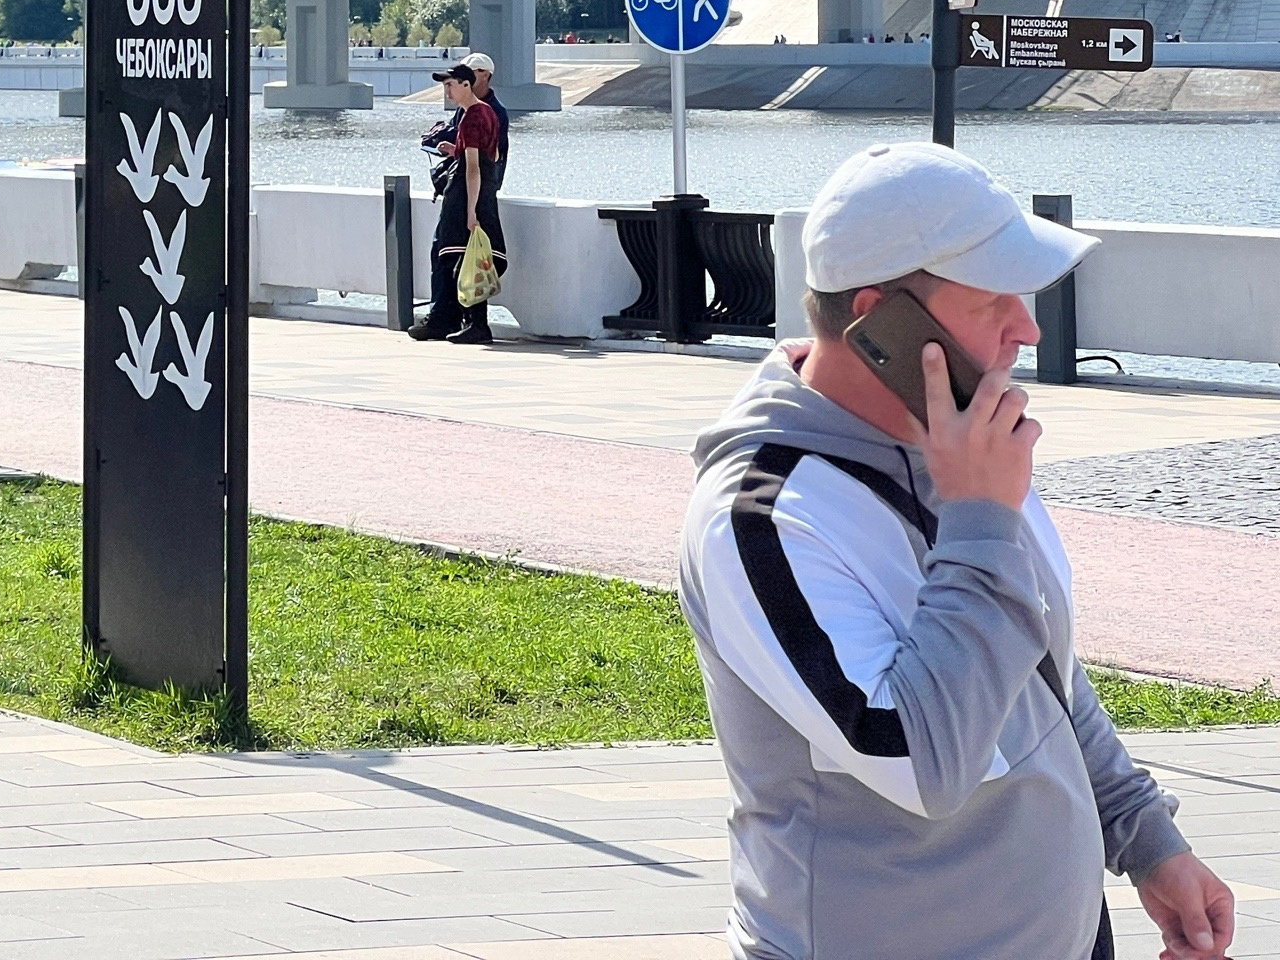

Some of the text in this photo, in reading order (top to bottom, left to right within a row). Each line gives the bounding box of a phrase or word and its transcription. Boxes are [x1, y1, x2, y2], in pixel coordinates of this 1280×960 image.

[1010, 19, 1068, 29] МОСКОВСКАЯ
[1010, 28, 1068, 38] НАБЕРЕЖНАЯ
[1010, 41, 1058, 51] Moskovskaya
[1081, 39, 1094, 48] 1,2
[116, 38, 212, 79] ЧЕБОКСАРЫ
[1009, 49, 1057, 58] Embankment
